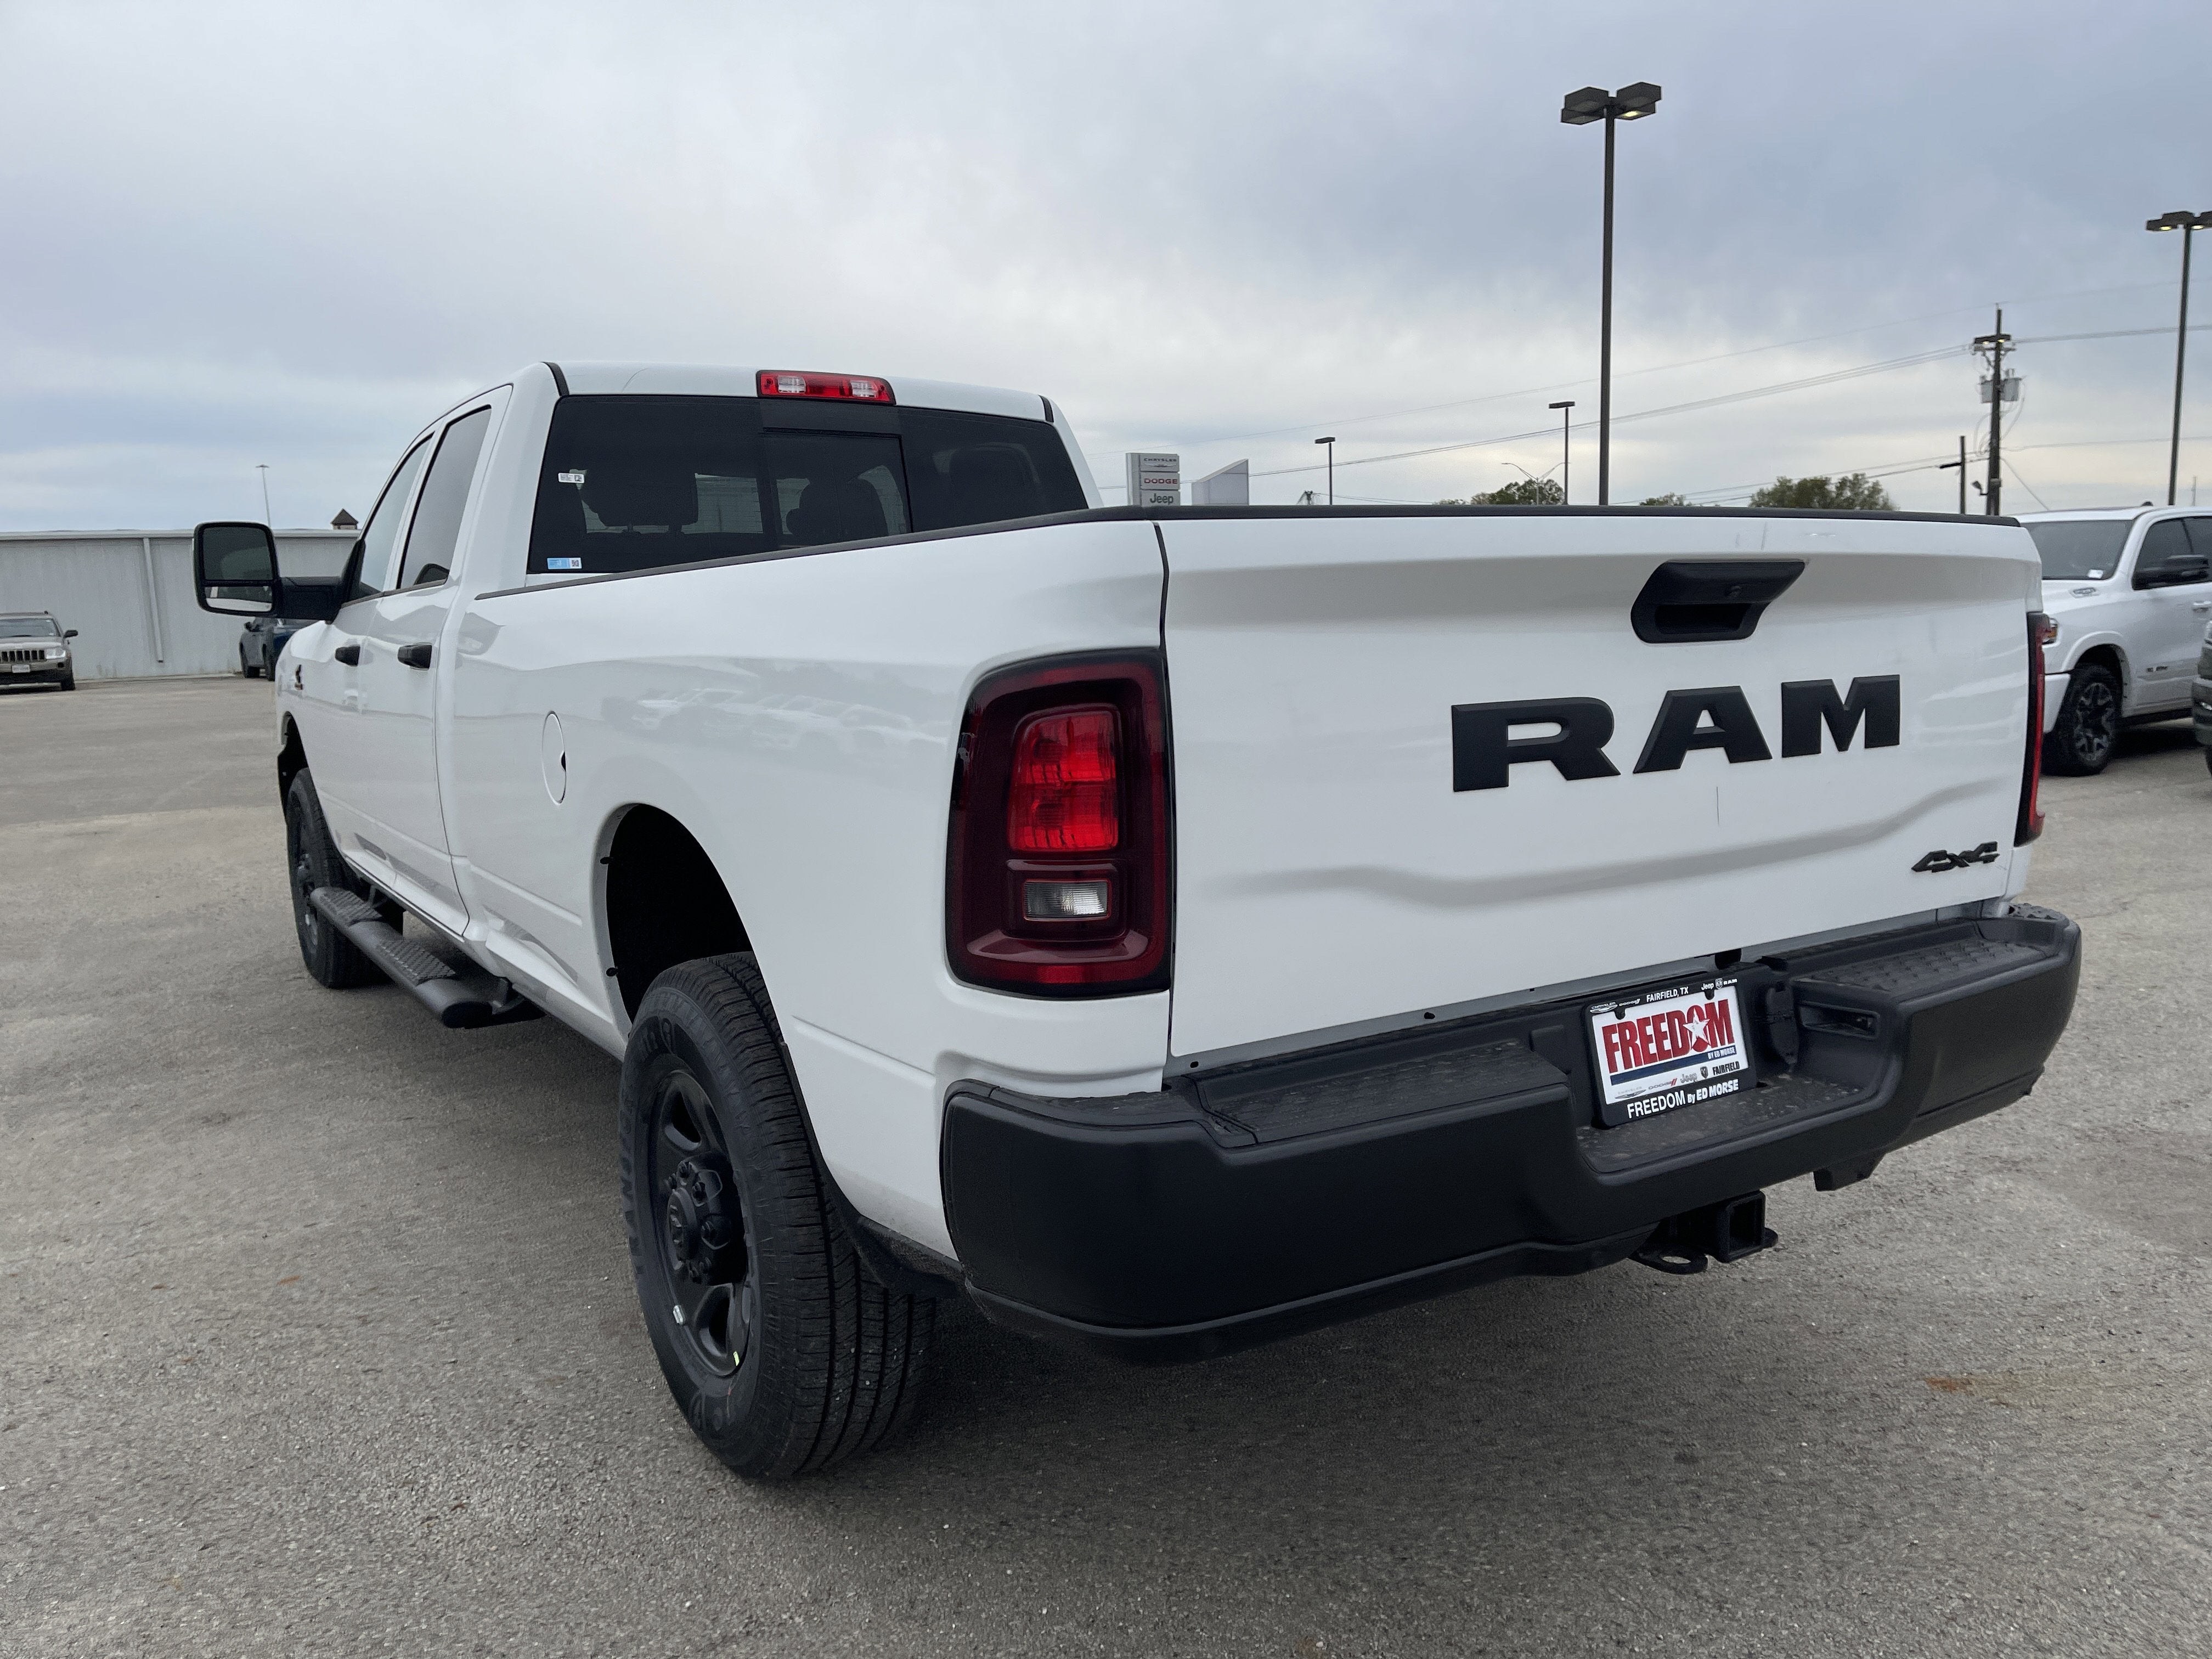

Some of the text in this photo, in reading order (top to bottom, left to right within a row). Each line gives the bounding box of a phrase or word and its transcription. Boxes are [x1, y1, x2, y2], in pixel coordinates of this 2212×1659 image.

[1150, 493, 1173, 505] Jeep
[1452, 674, 1900, 792] RAM
[1646, 989, 1679, 1002] FAIRFIELD,
[1680, 986, 1689, 995] TX
[1602, 998, 1735, 1074] FREEDOM
[1680, 1073, 1697, 1083] Jeep
[1712, 1061, 1740, 1076] FAIRFIELD
[1627, 1090, 1686, 1119] FREEDOM
[1696, 1087, 1708, 1101] ED
[1709, 1079, 1739, 1097] MORSE
